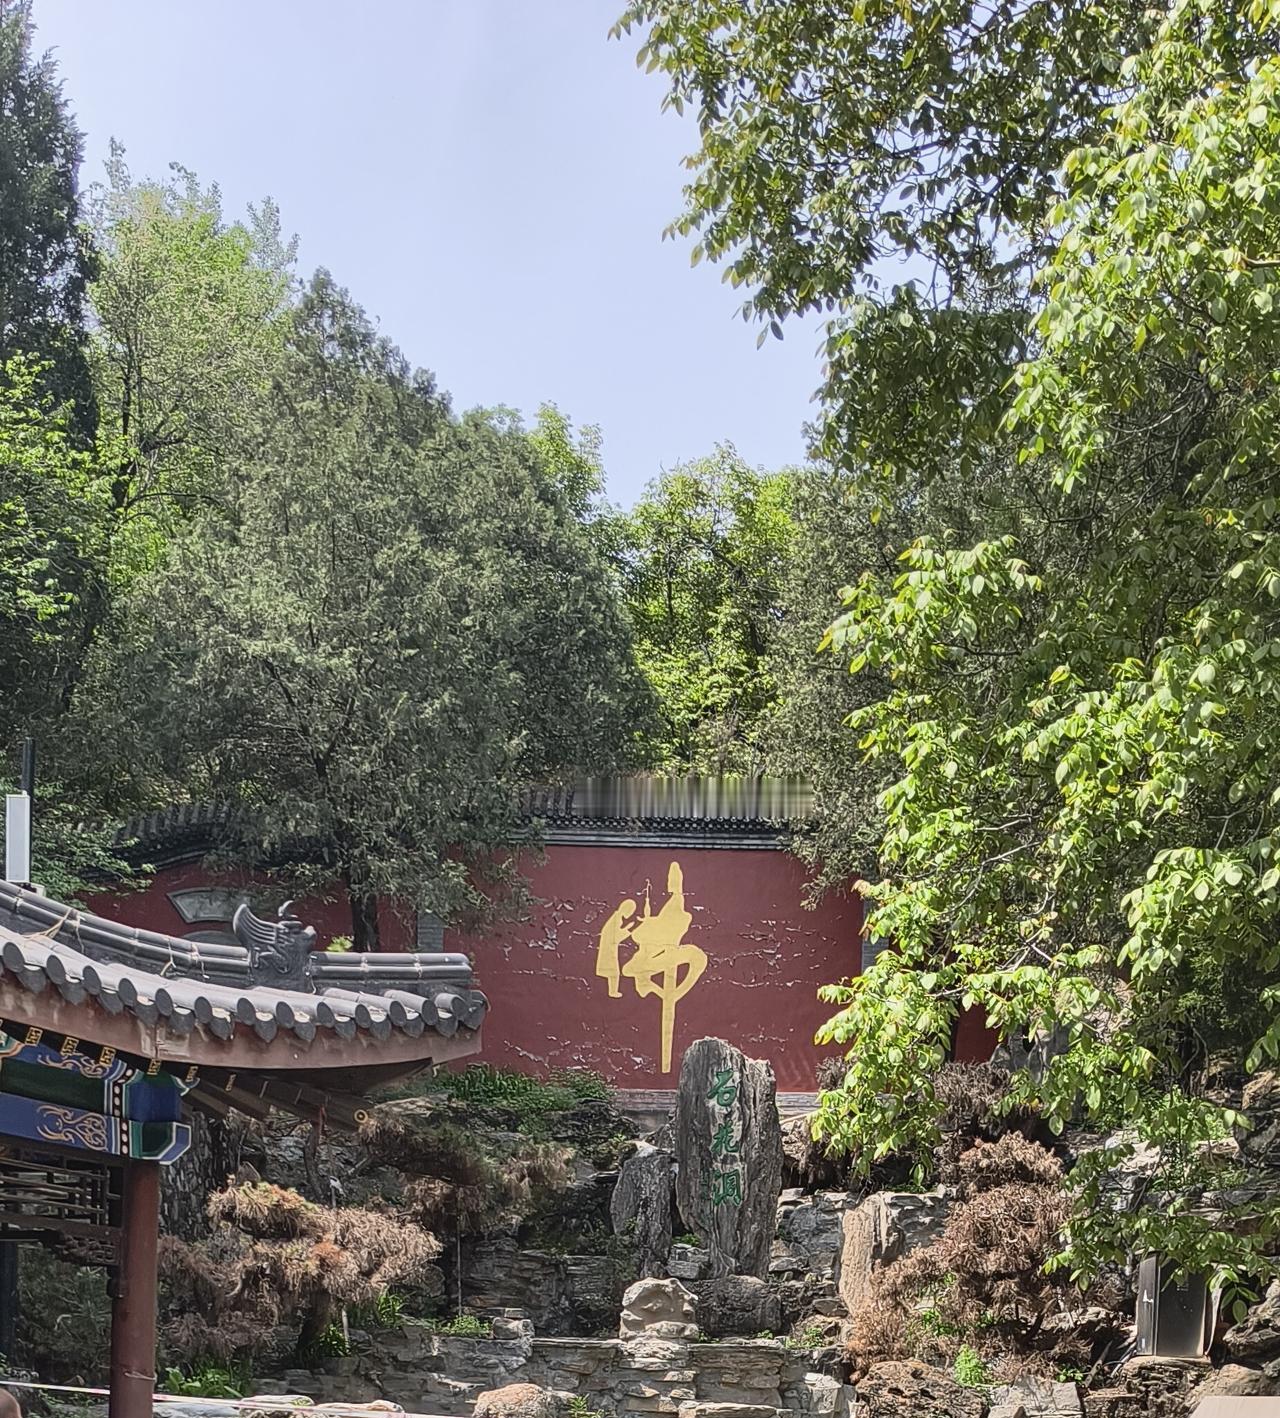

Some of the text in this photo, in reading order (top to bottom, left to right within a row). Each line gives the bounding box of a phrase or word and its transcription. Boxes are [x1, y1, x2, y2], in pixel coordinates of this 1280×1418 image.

[595, 861, 708, 1074] 佛
[706, 1067, 742, 1206] 石花洞
